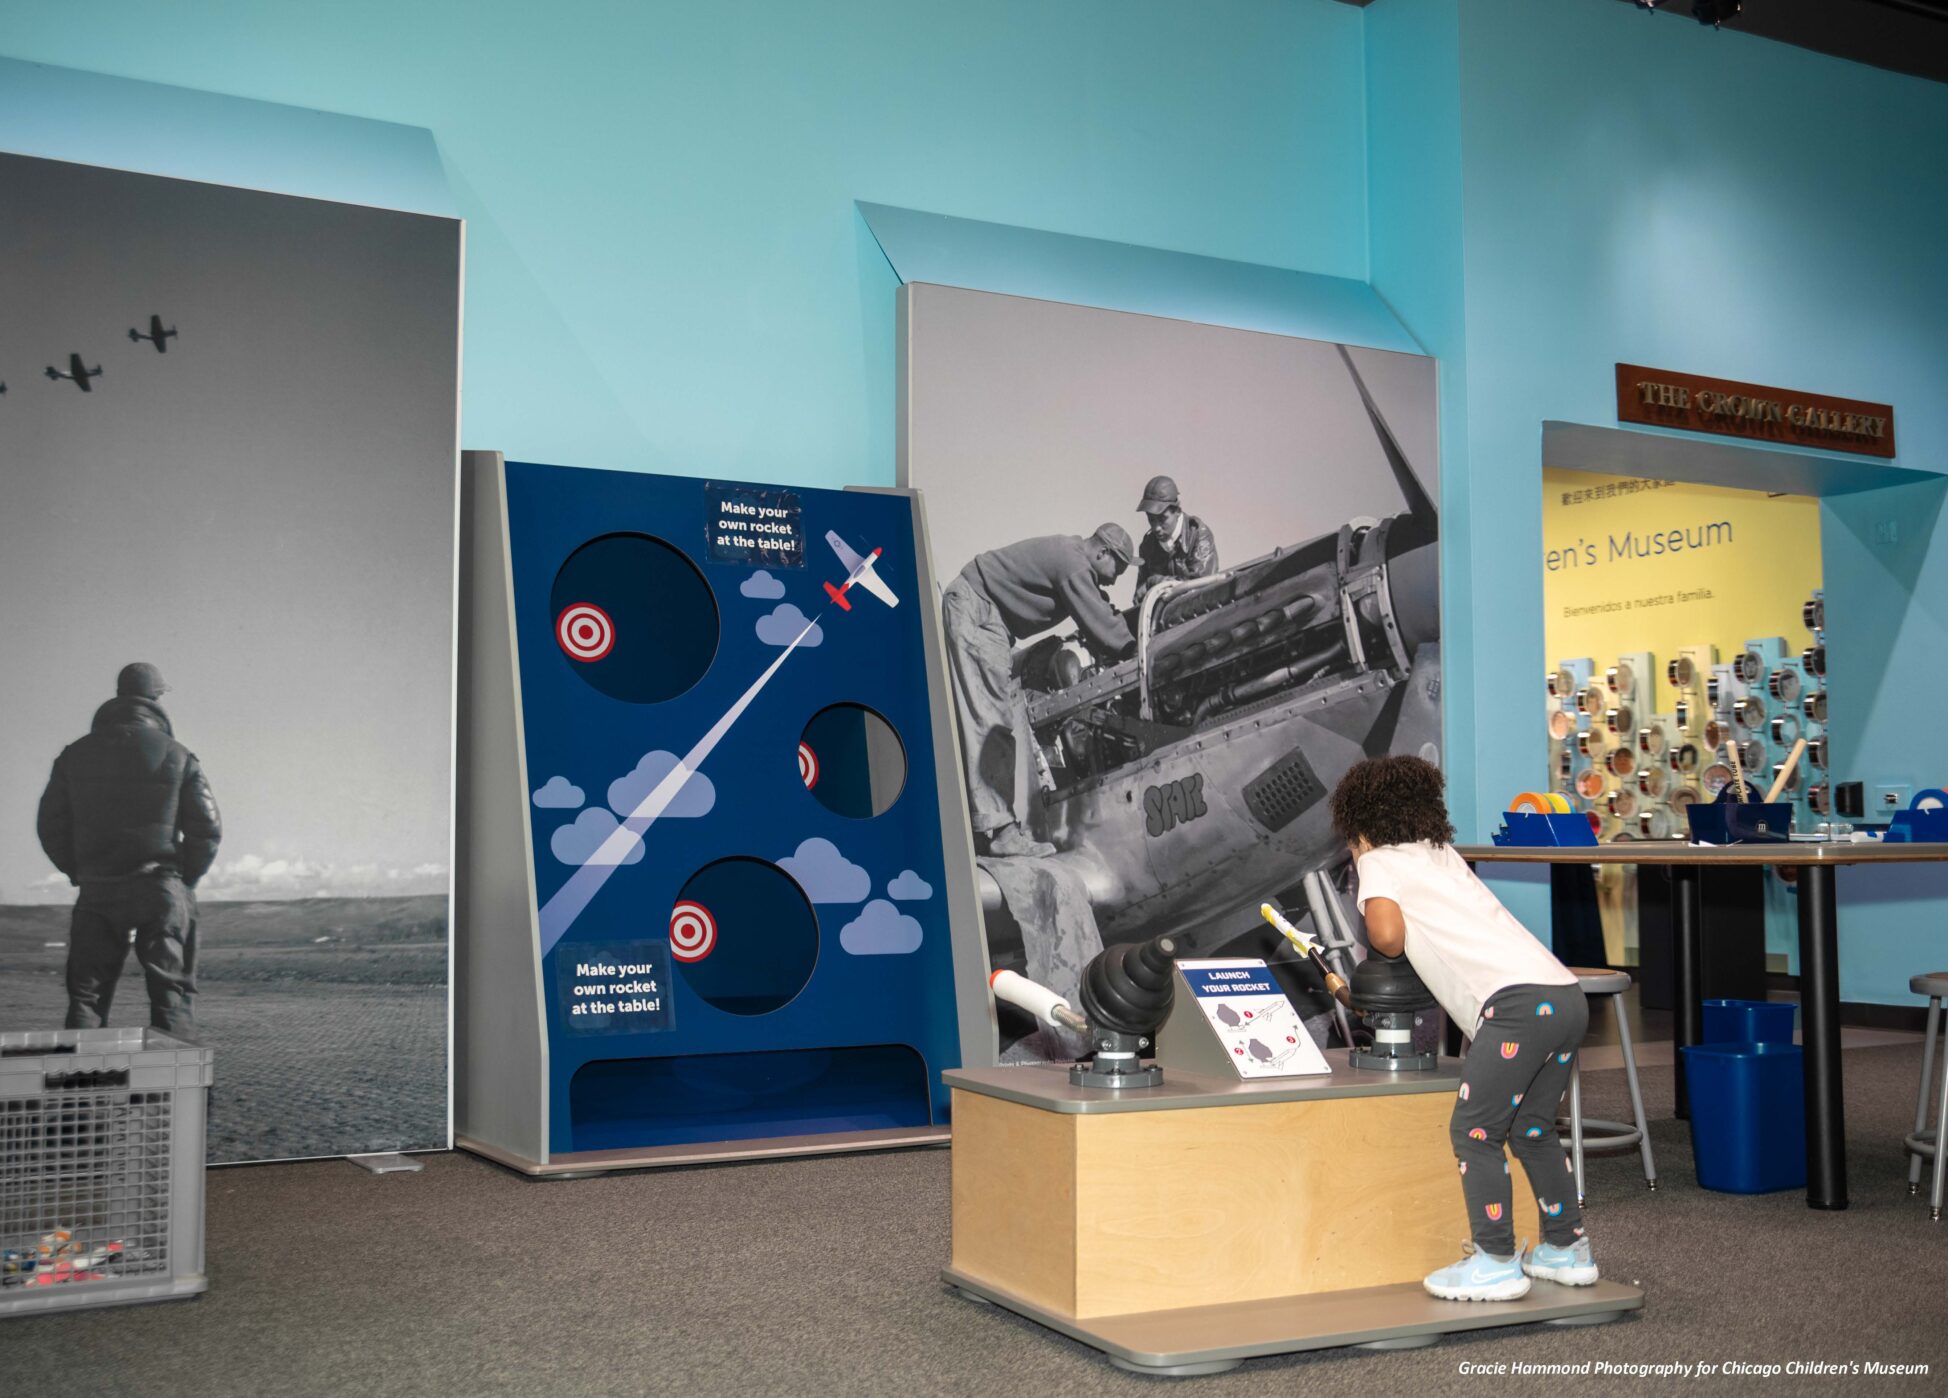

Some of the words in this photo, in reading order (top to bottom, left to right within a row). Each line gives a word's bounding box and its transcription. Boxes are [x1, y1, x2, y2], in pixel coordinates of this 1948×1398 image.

[1637, 381, 1691, 409] THE
[1695, 390, 1782, 423] CROWN
[1785, 404, 1887, 438] GALLERY
[721, 501, 756, 515] Make
[758, 507, 788, 518] your
[718, 520, 747, 531] own
[750, 521, 792, 534] rocket
[717, 535, 730, 546] at
[733, 535, 755, 547] the
[758, 538, 795, 551] table!
[1543, 538, 1598, 571] en's
[1608, 521, 1733, 562] Museum
[1563, 600, 1622, 618] Bienvenidos
[1625, 600, 1632, 610] a
[1634, 593, 1674, 609] nuestra
[576, 963, 616, 977] Make
[618, 964, 652, 978] your
[1208, 971, 1251, 980] LAUNCH
[573, 984, 606, 996] own
[609, 980, 657, 994] rocket
[1202, 984, 1231, 993] YOUR
[1231, 983, 1271, 992] ROCKET
[572, 1002, 588, 1015] at
[590, 1001, 615, 1014] the
[618, 998, 660, 1012] table!
